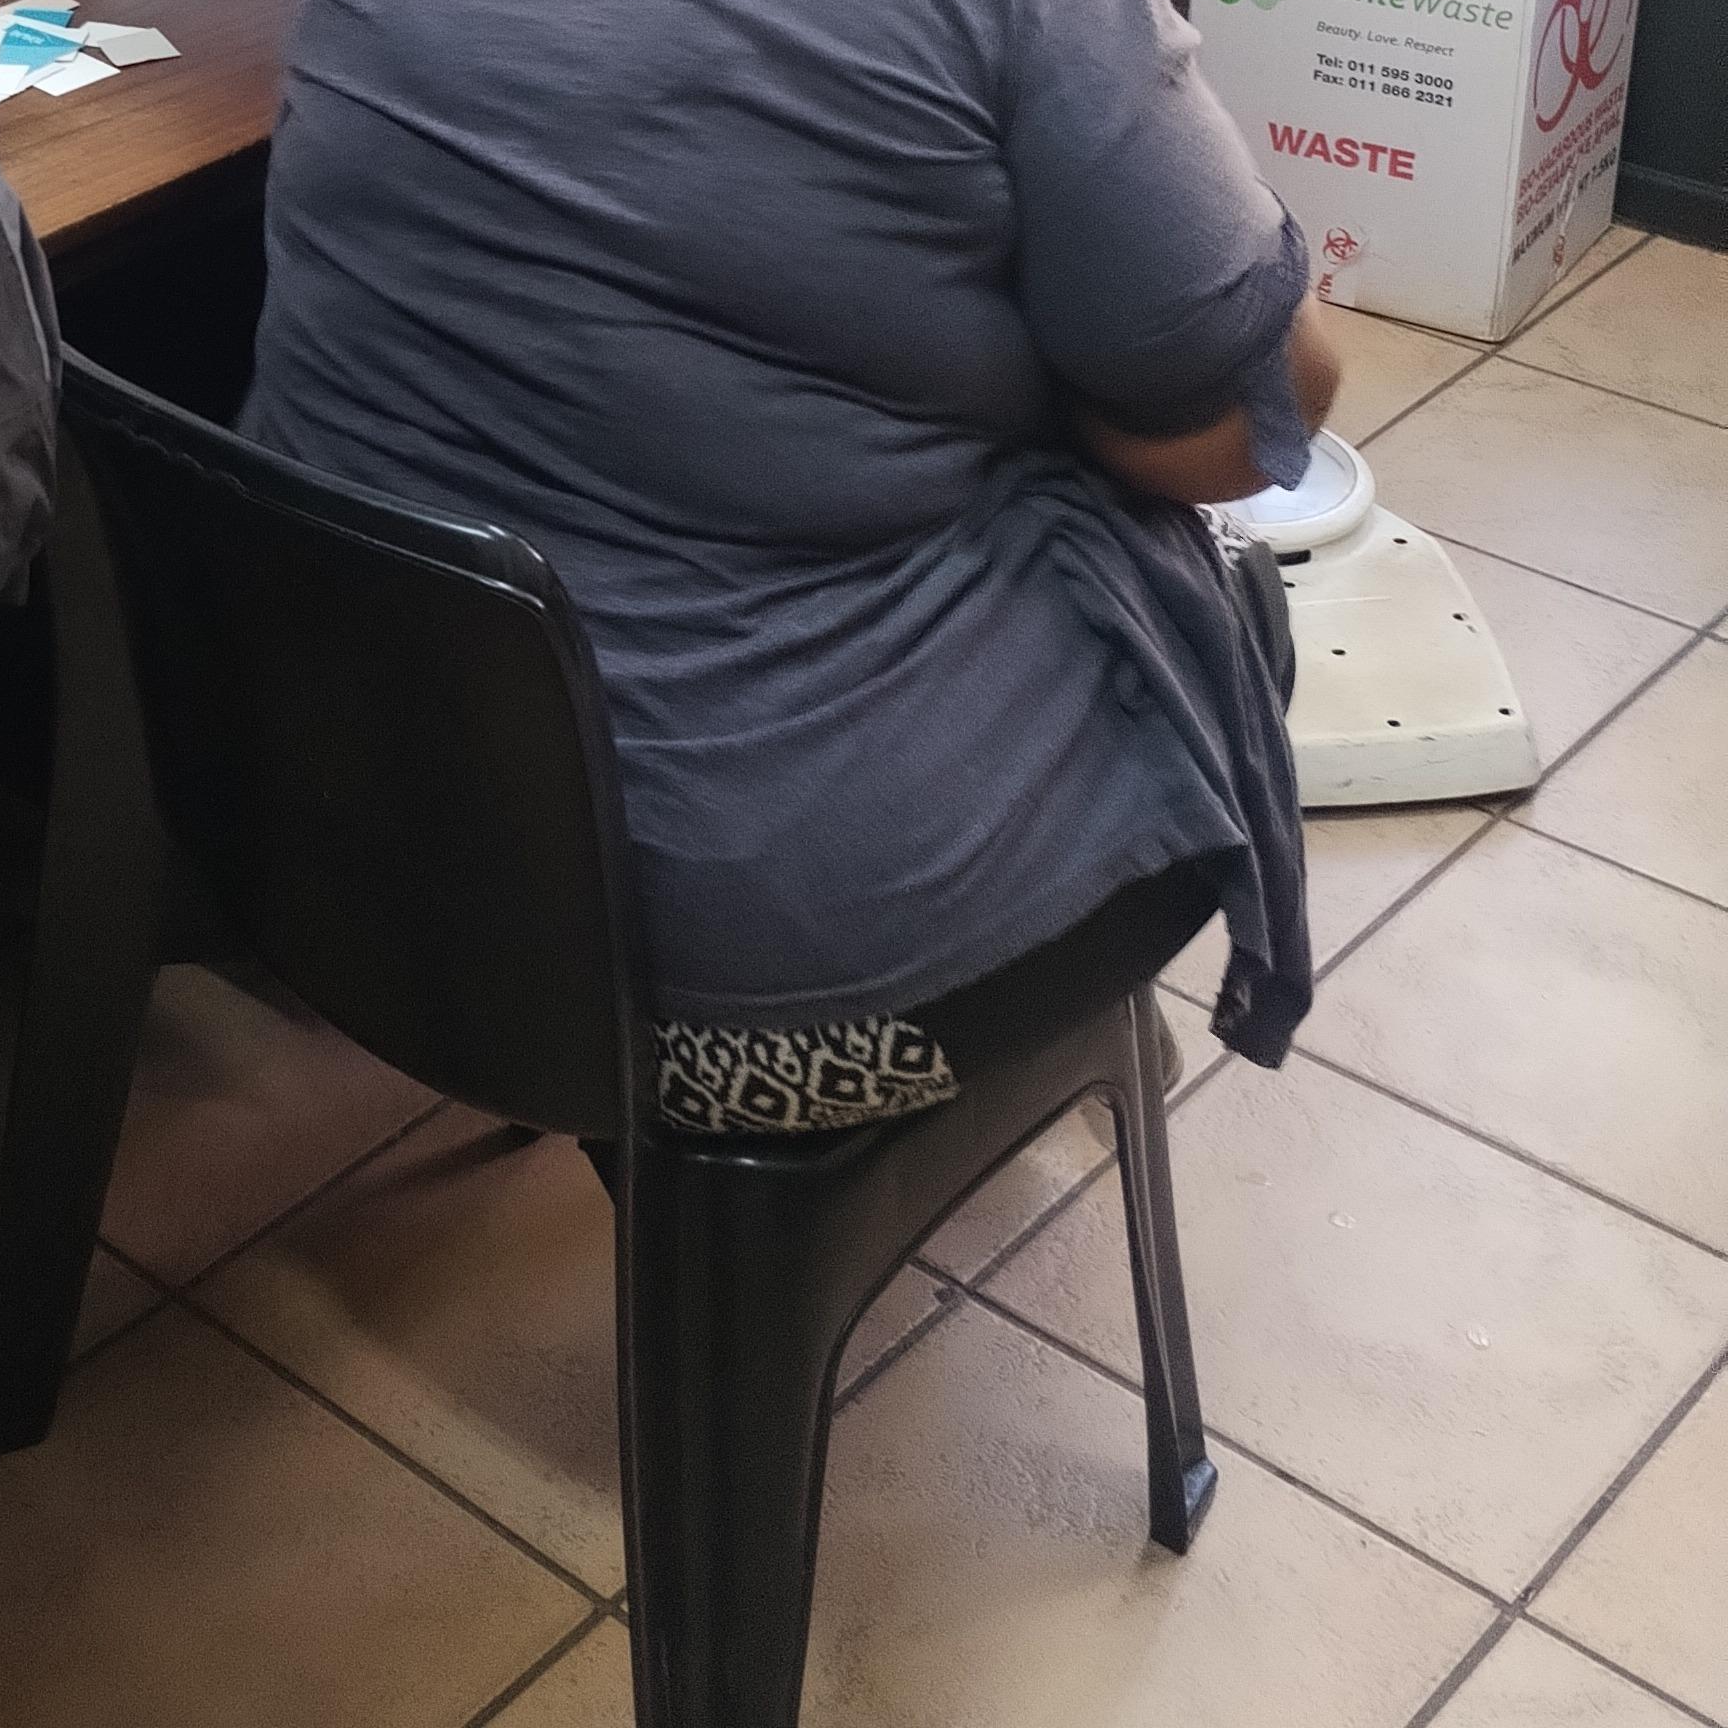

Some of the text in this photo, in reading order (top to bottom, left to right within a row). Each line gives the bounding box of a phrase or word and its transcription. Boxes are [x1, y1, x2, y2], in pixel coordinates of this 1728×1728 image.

[1404, 37, 1454, 57] Respect
[1312, 69, 1454, 108] Fax: 011 866 2321
[1316, 53, 1454, 91] Tel: 011 595 3000
[1268, 121, 1416, 181] WASTE
